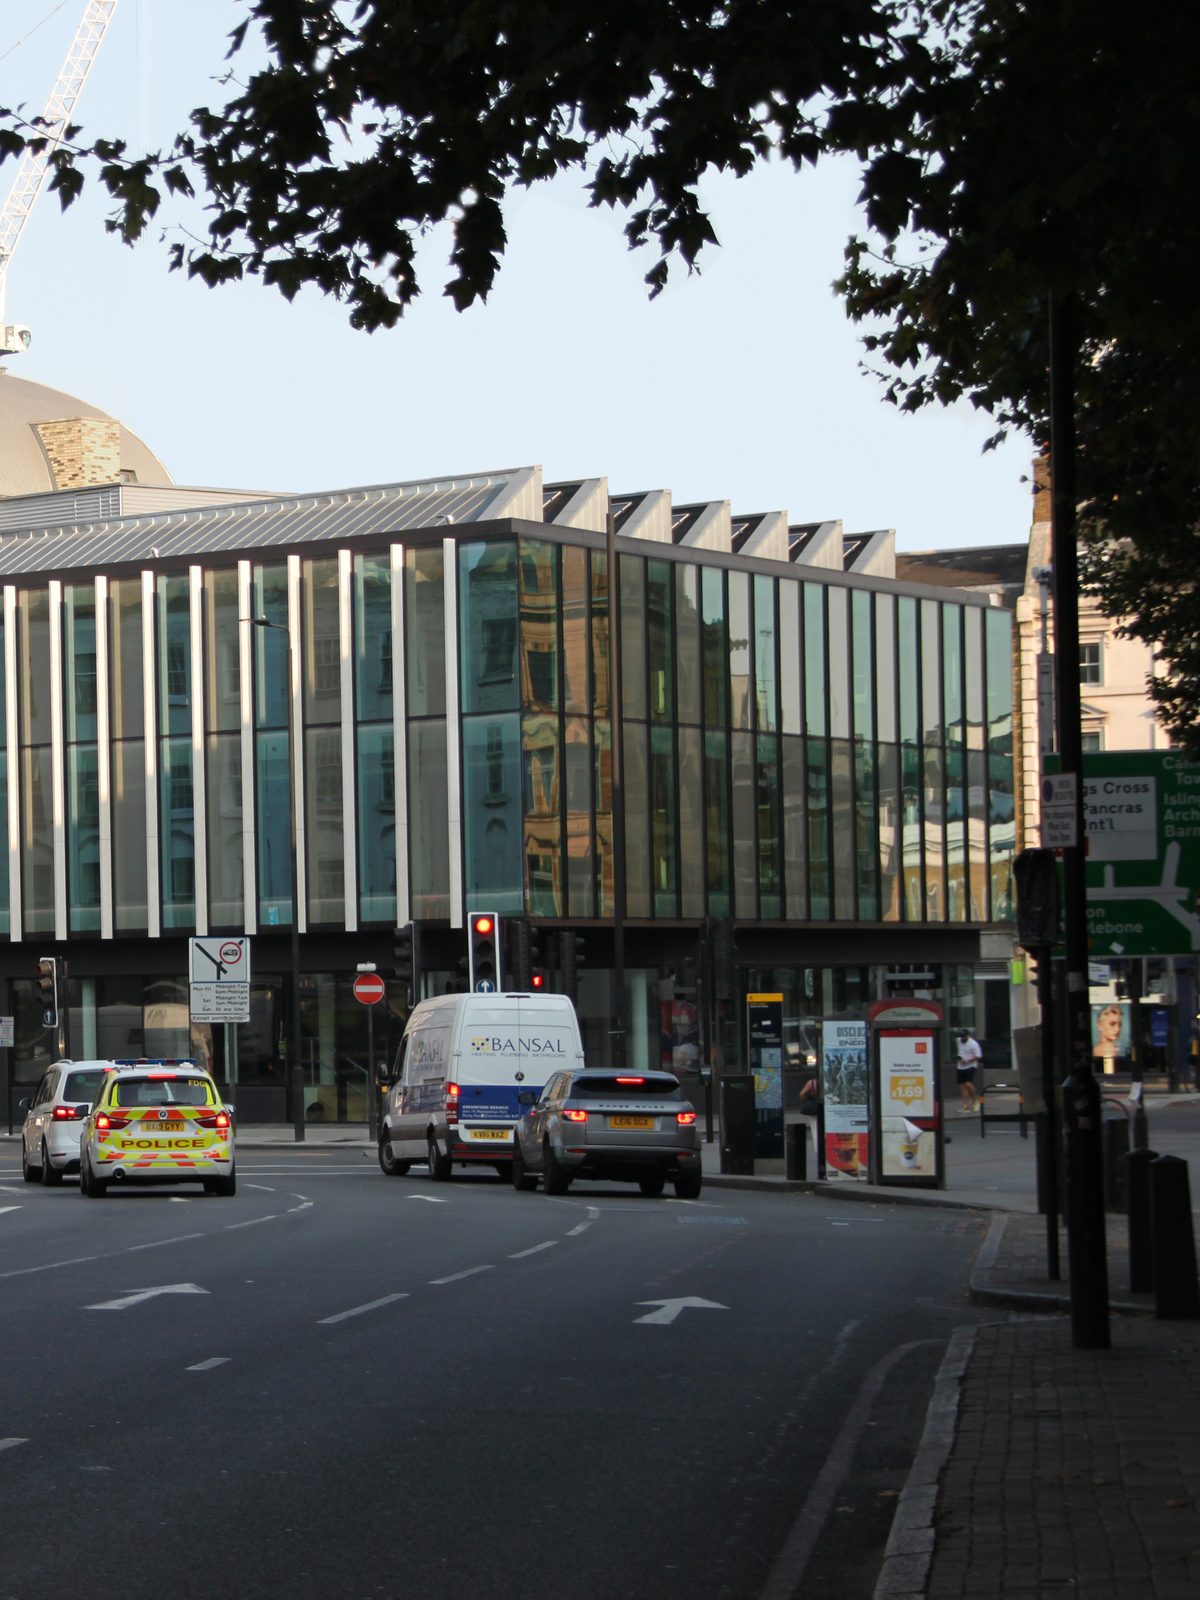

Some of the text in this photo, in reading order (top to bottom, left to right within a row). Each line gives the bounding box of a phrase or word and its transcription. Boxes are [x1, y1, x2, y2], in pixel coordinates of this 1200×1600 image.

[1103, 782, 1150, 794] Cross
[1054, 791, 1074, 800] ROUTE
[492, 1038, 566, 1052] BANSAL
[121, 1139, 205, 1148] POLICE
